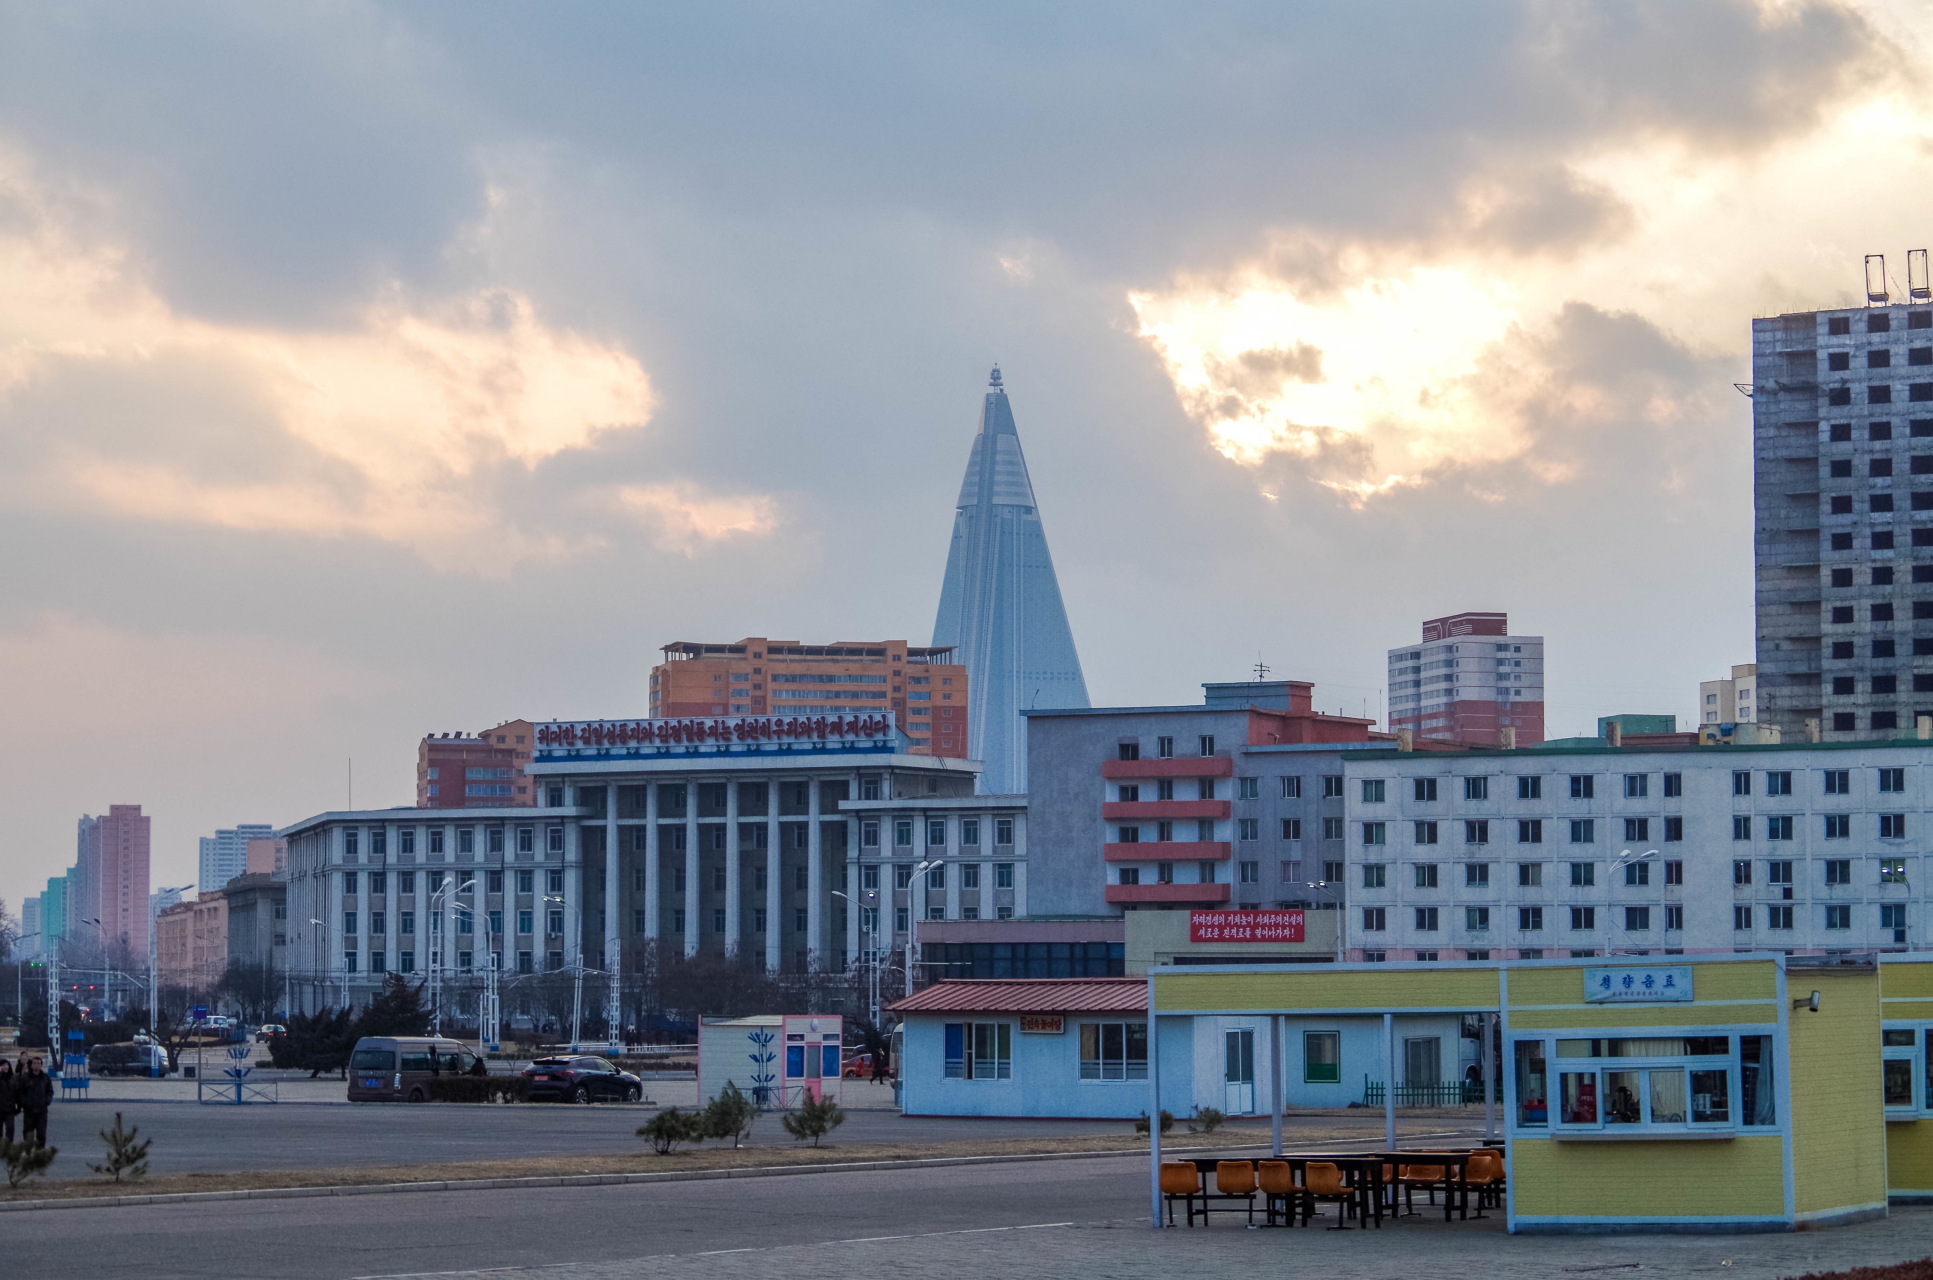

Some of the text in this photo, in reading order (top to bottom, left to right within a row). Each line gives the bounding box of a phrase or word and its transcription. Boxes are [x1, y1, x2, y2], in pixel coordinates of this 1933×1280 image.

[537, 724, 577, 746] 위대한
[733, 718, 771, 741] 영원히
[772, 717, 813, 740] 우리와
[814, 715, 843, 739] 함께
[844, 714, 889, 738] 계신다
[1191, 913, 1225, 925] 자력갱생의
[1227, 913, 1253, 925] 기치높이
[1197, 927, 1294, 938] 새로운 진격로를 열어나가자!
